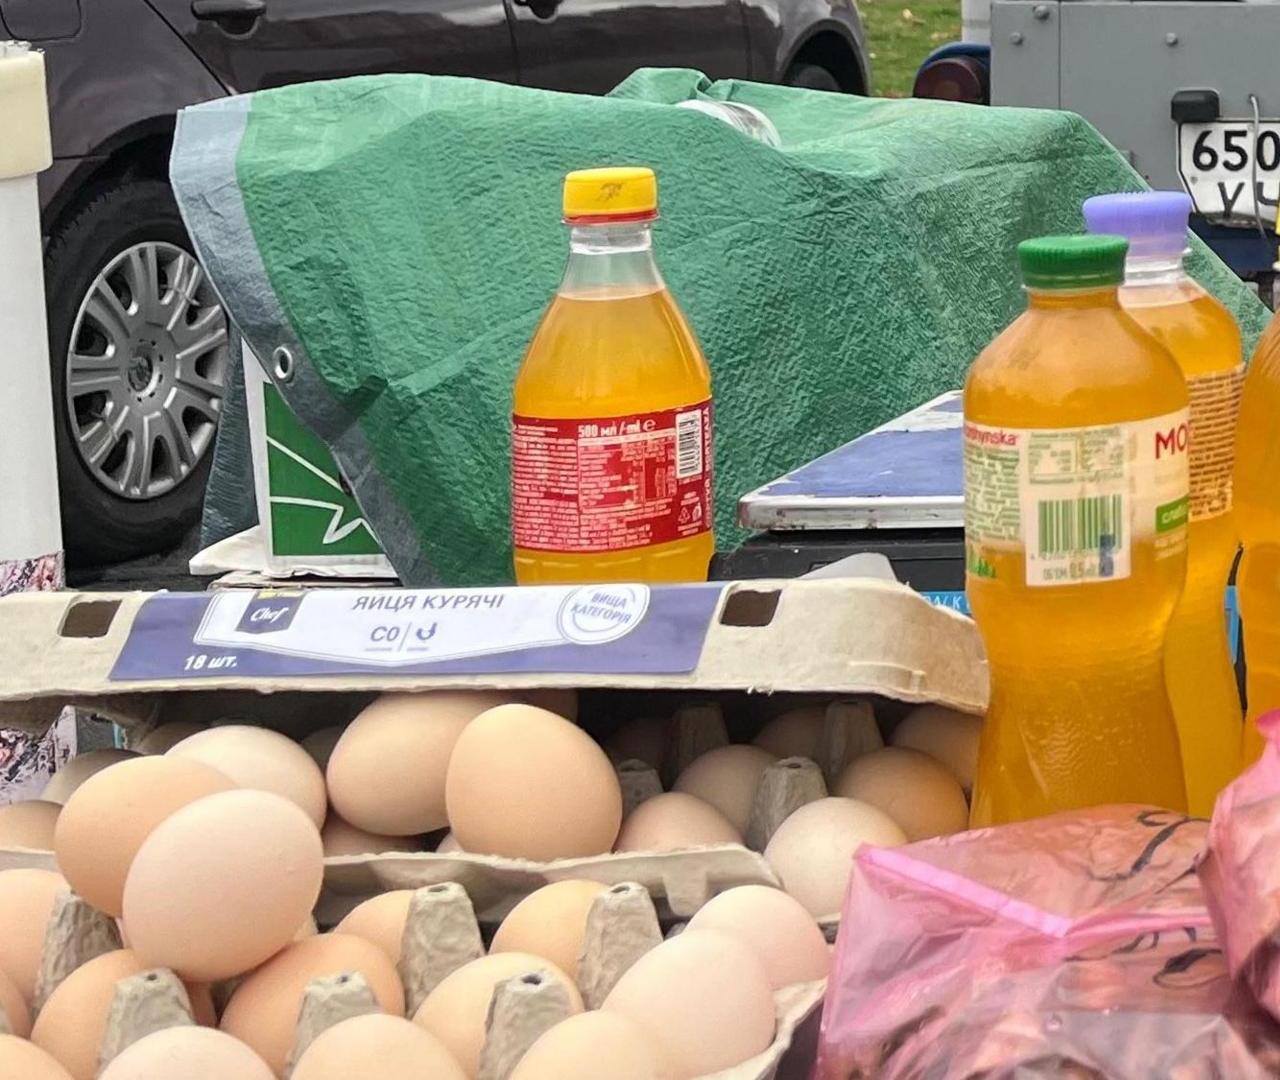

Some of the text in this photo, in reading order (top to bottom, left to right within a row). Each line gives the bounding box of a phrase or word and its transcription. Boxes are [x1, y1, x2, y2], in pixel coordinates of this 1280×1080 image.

[352, 594, 505, 612] ЯЙЦЯ КУРЯЧІ
[570, 602, 633, 624] КАТЕГОРІЯ
[208, 656, 238, 669] шт.
